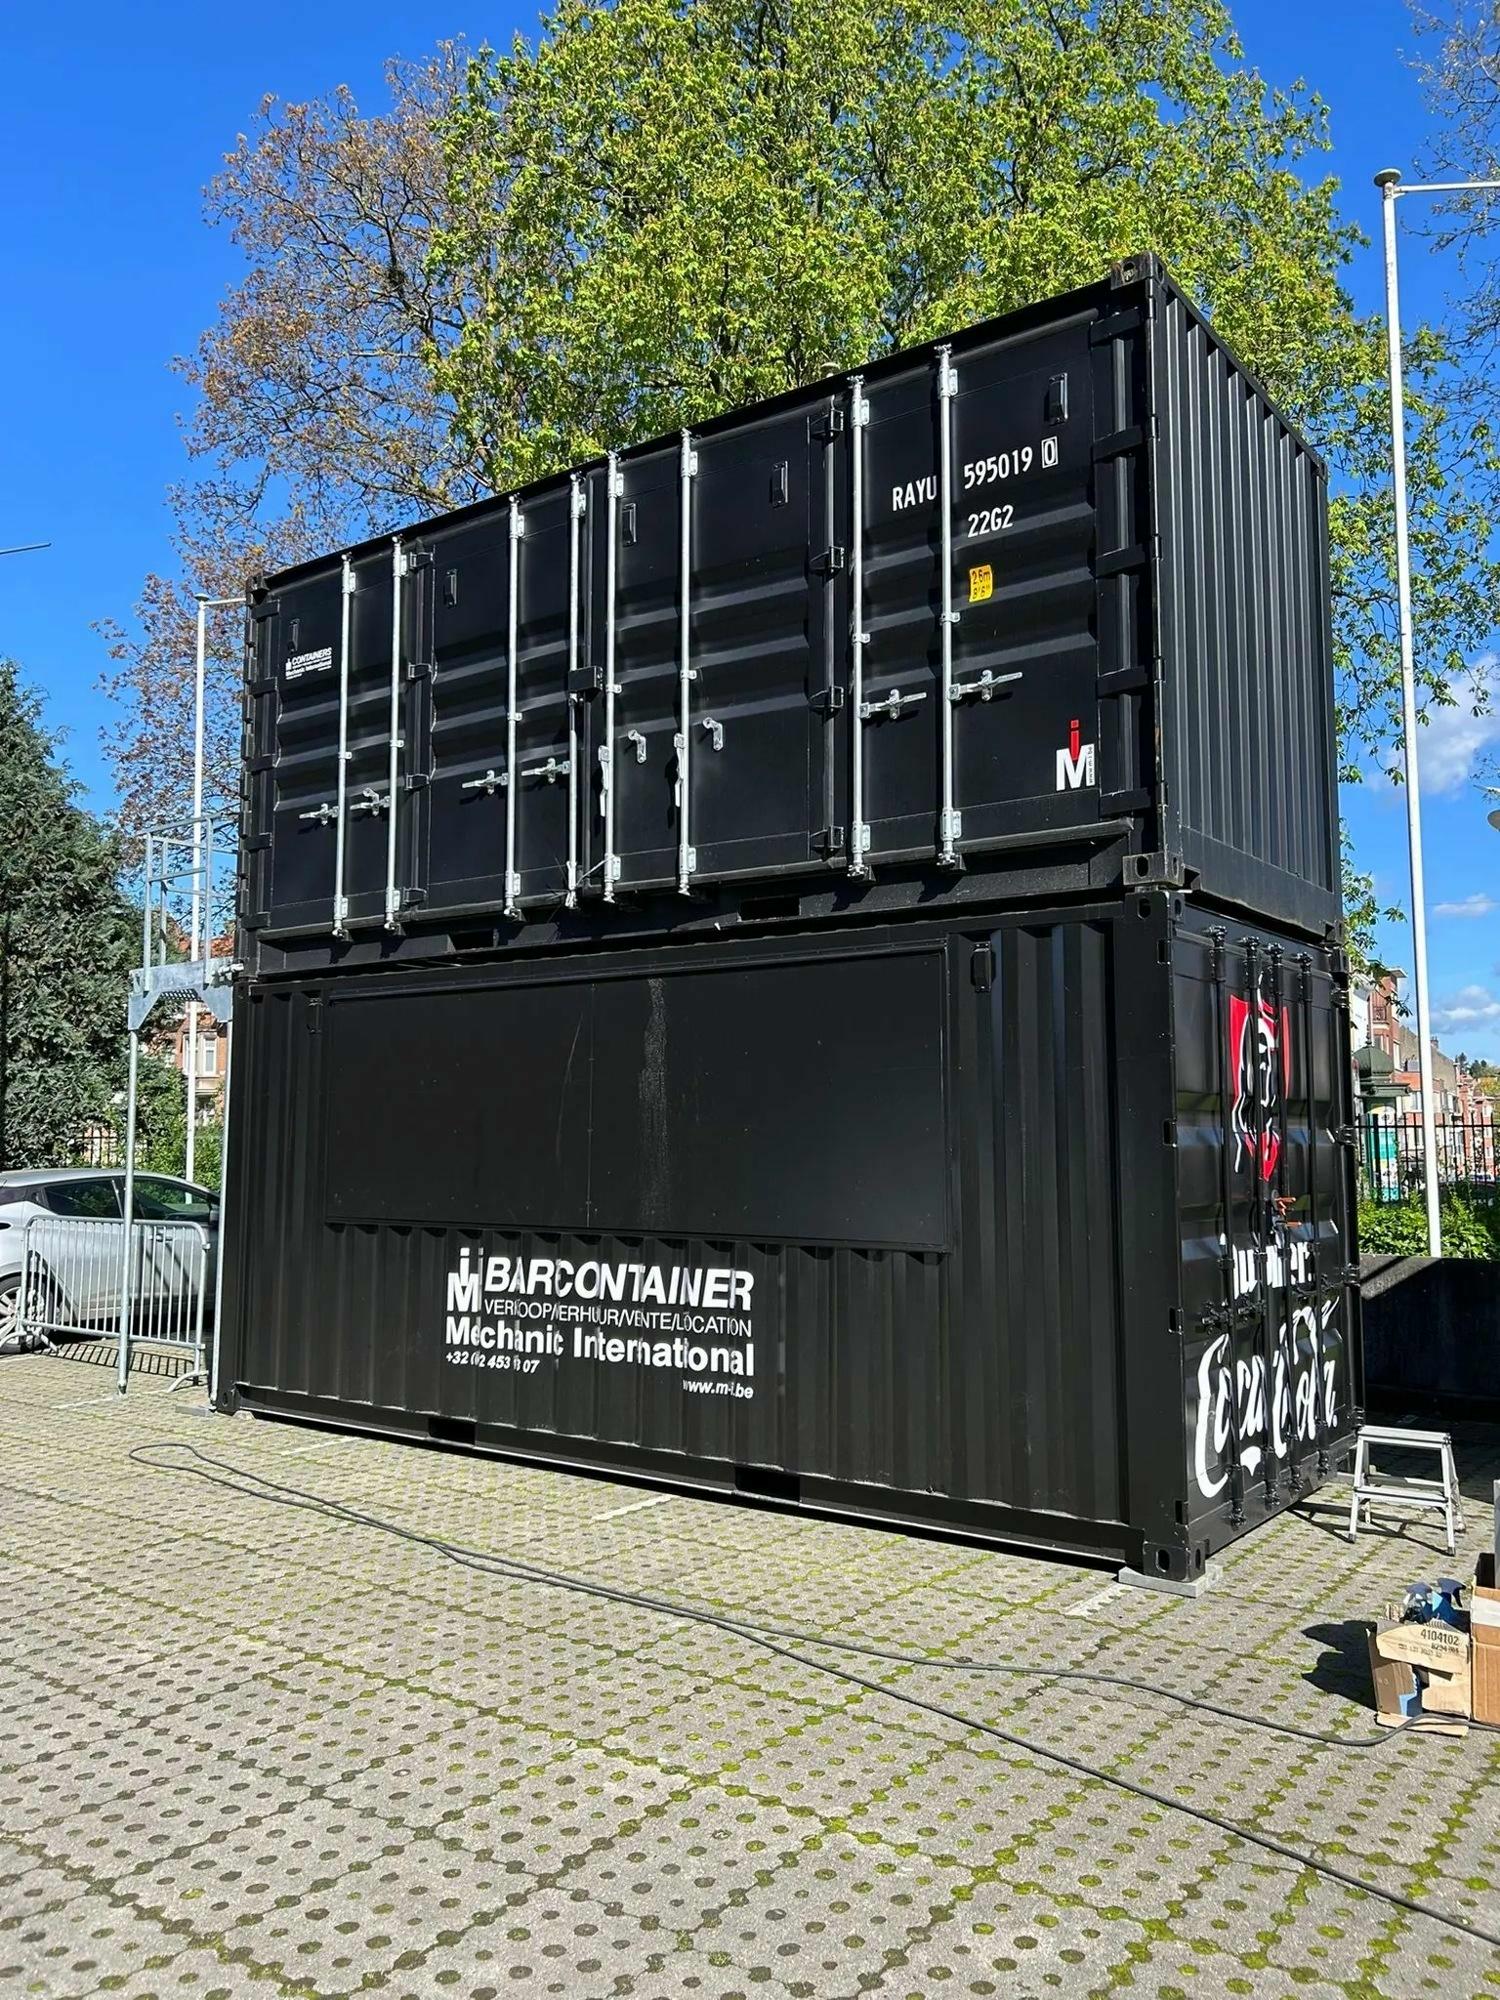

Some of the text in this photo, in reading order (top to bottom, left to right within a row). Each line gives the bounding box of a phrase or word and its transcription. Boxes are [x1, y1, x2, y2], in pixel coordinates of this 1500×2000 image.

[892, 437, 1057, 511] RAYU 595019 0
[967, 504, 1013, 538] 22G2
[292, 647, 332, 666] CONTAINERS
[485, 1256, 754, 1311] BARCONTAINER
[523, 1359, 540, 1374] 07
[573, 1327, 754, 1376] International
[1420, 1628, 1459, 1646] 4104102
